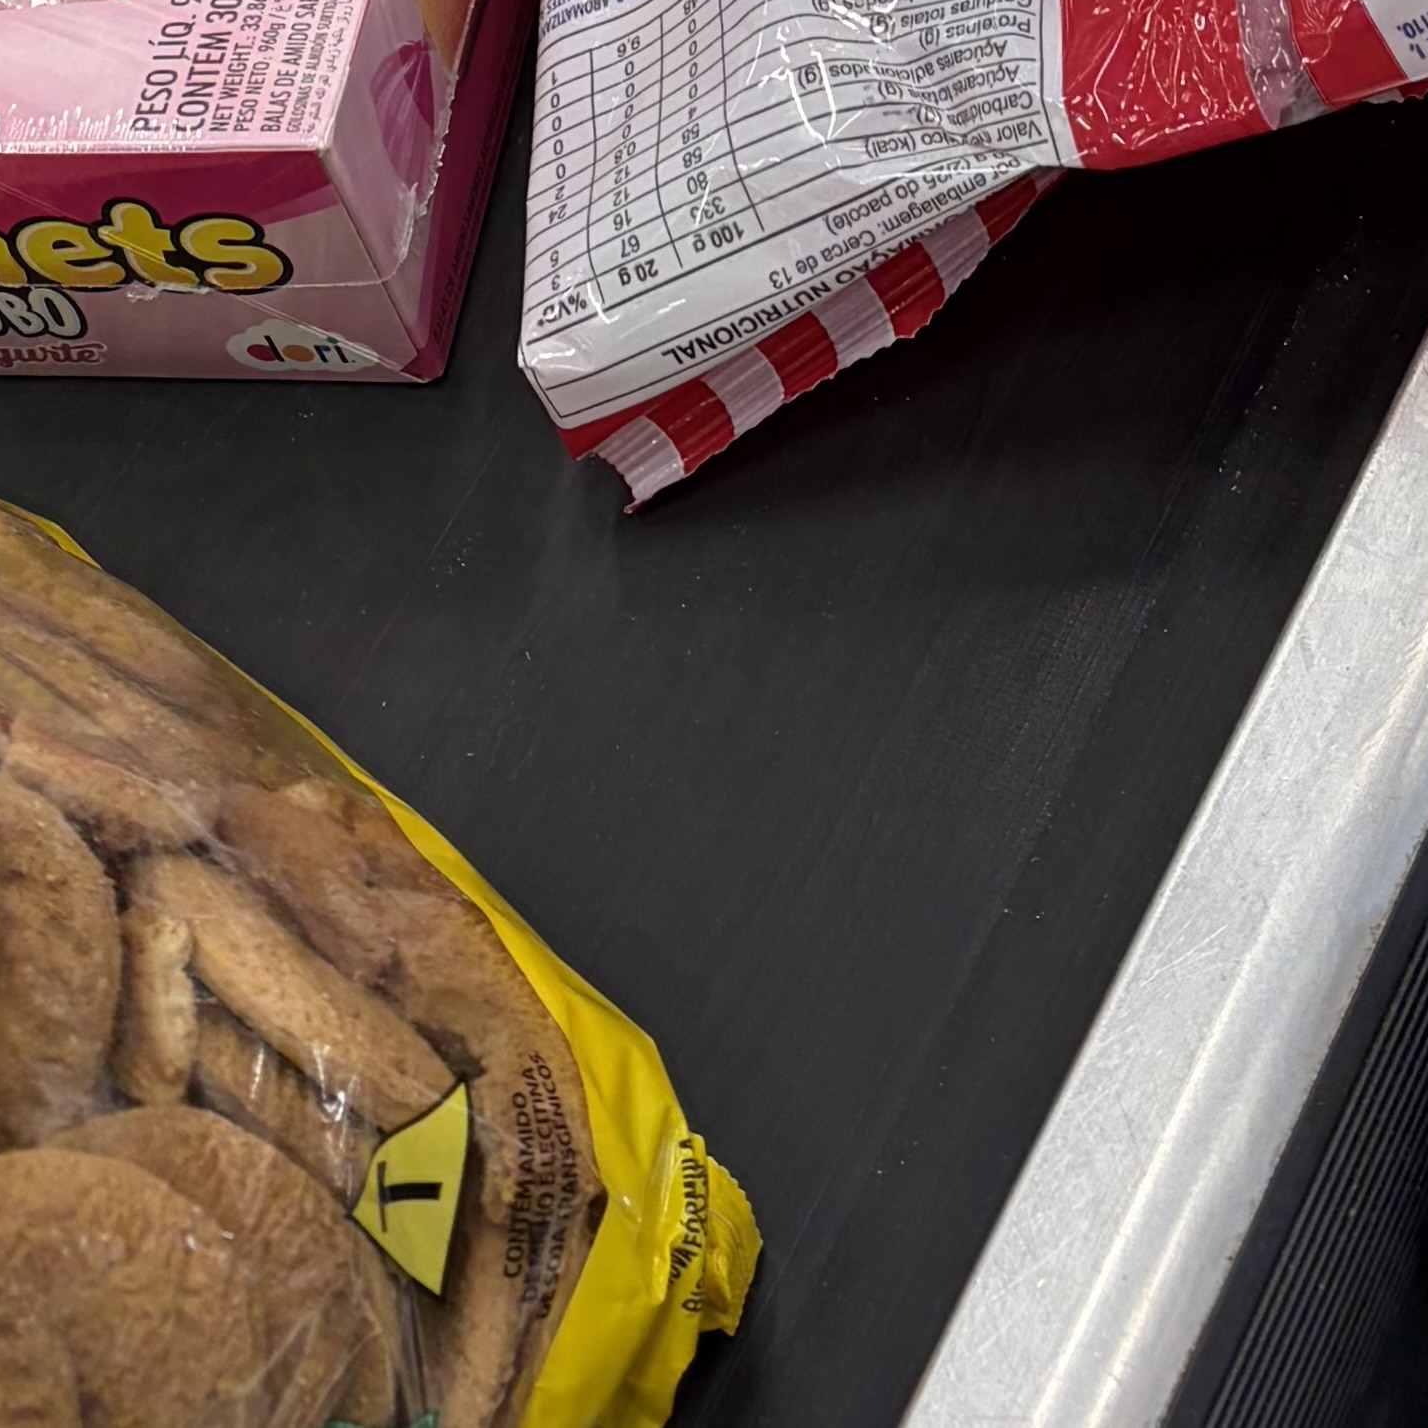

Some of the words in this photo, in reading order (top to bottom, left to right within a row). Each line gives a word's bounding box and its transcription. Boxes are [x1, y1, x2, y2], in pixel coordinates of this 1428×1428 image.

[900, 6, 946, 32] totais
[280, 22, 313, 67] AMIDO
[918, 27, 941, 50] (g)
[274, 68, 298, 88] DE
[130, 69, 179, 133] PESO
[259, 89, 292, 133] BALAS
[208, 102, 235, 133] NET
[232, 97, 260, 132] PESO
[997, 119, 1042, 143] Valor
[864, 131, 917, 158] (kcal)
[547, 203, 569, 225] 24
[613, 209, 633, 230] 16
[620, 234, 642, 259] 67
[693, 231, 707, 254] g
[711, 221, 745, 249] 100
[829, 228, 879, 263] Cerca
[618, 266, 632, 287] g
[637, 258, 660, 282] 20
[796, 253, 820, 275] de
[768, 265, 794, 290] 13
[660, 272, 835, 367] NUTRICIONAL
[521, 1066, 556, 1162] LECITINA
[511, 1091, 535, 1175] AMIDO
